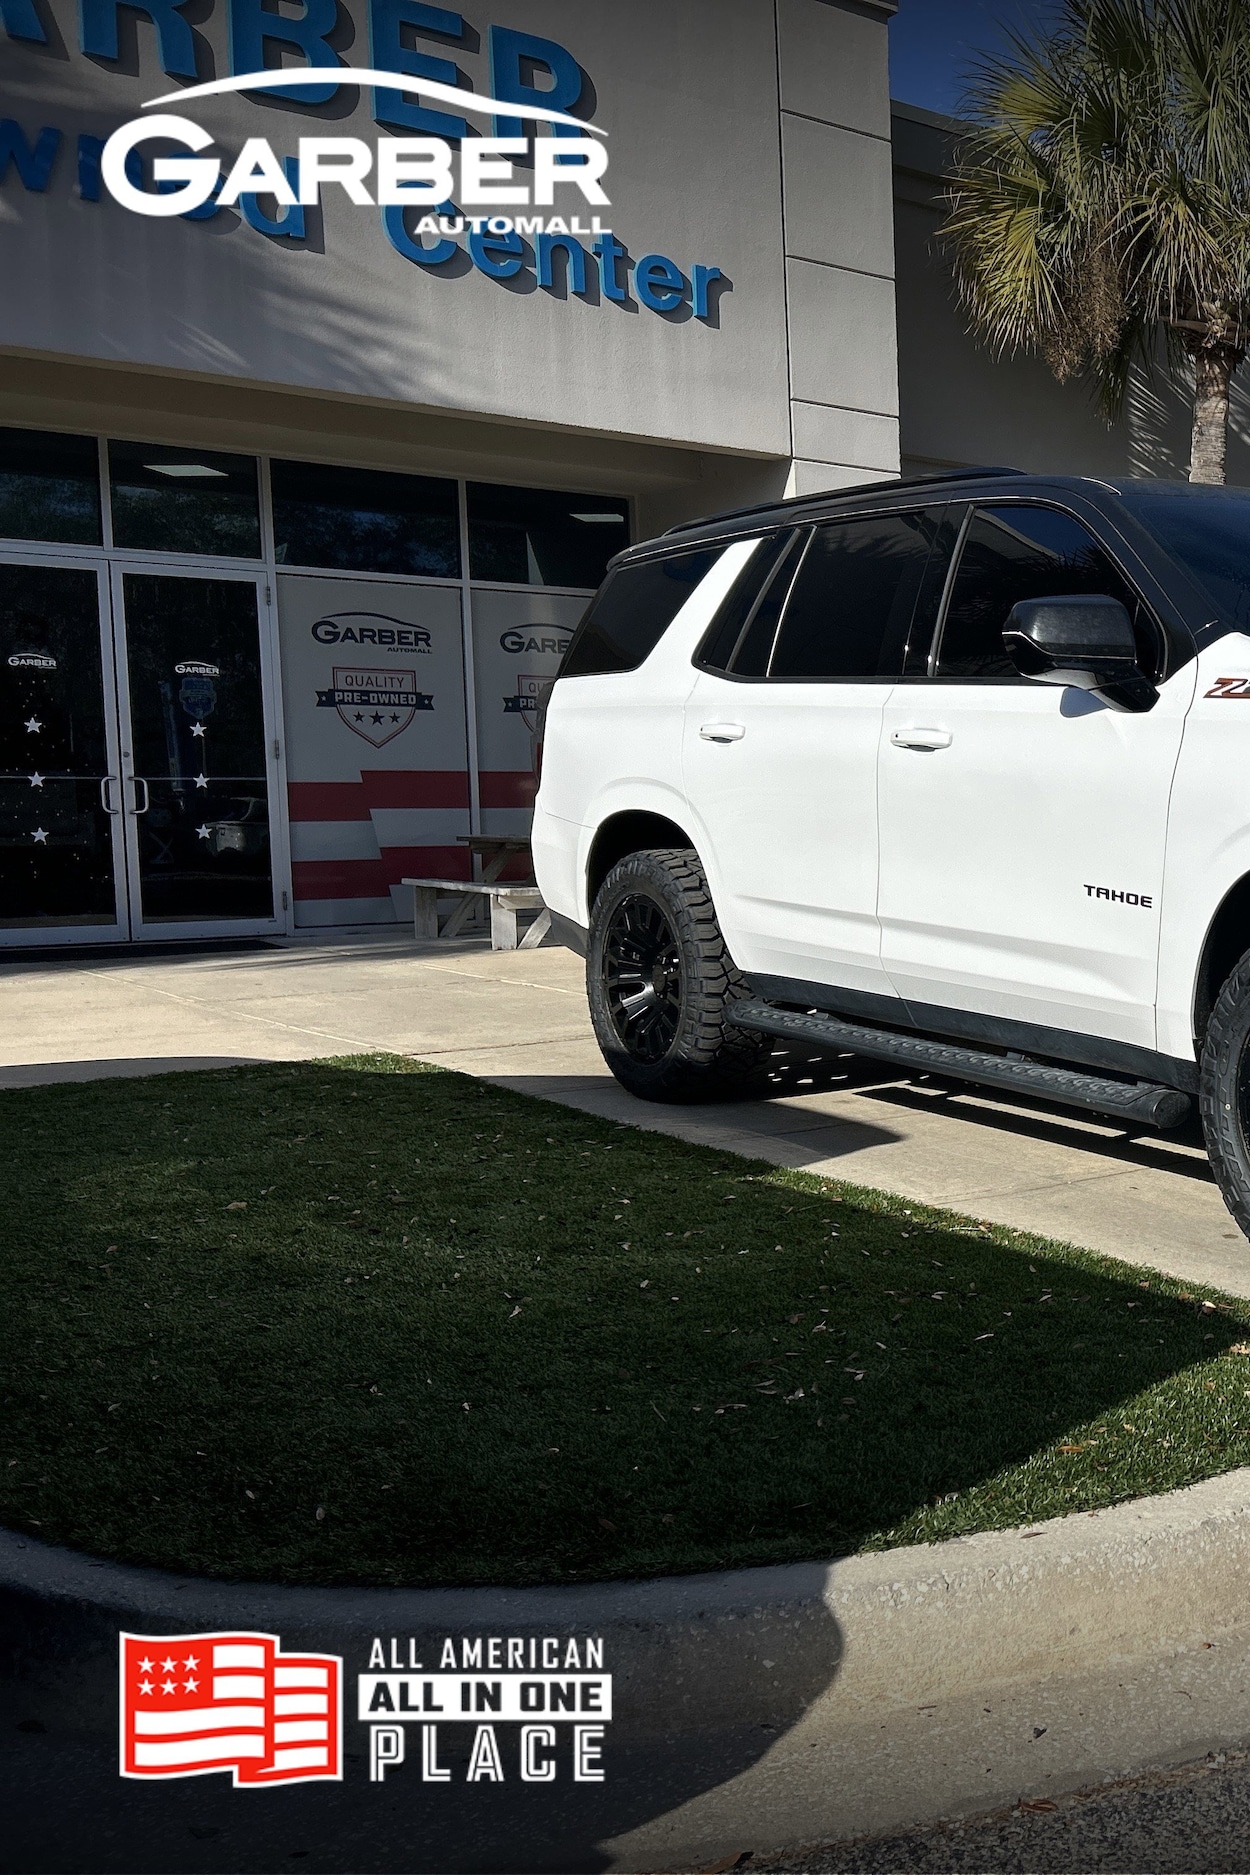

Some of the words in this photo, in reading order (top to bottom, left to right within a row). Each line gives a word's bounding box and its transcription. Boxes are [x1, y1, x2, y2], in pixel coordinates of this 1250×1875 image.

[381, 180, 721, 318] Center
[311, 620, 432, 648] GARBER
[8, 656, 57, 667] GARBER
[175, 665, 220, 675] GARBER
[345, 675, 405, 689] QUALITY
[334, 691, 417, 705] PRE-OWNED
[1083, 884, 1153, 909] TAHOE
